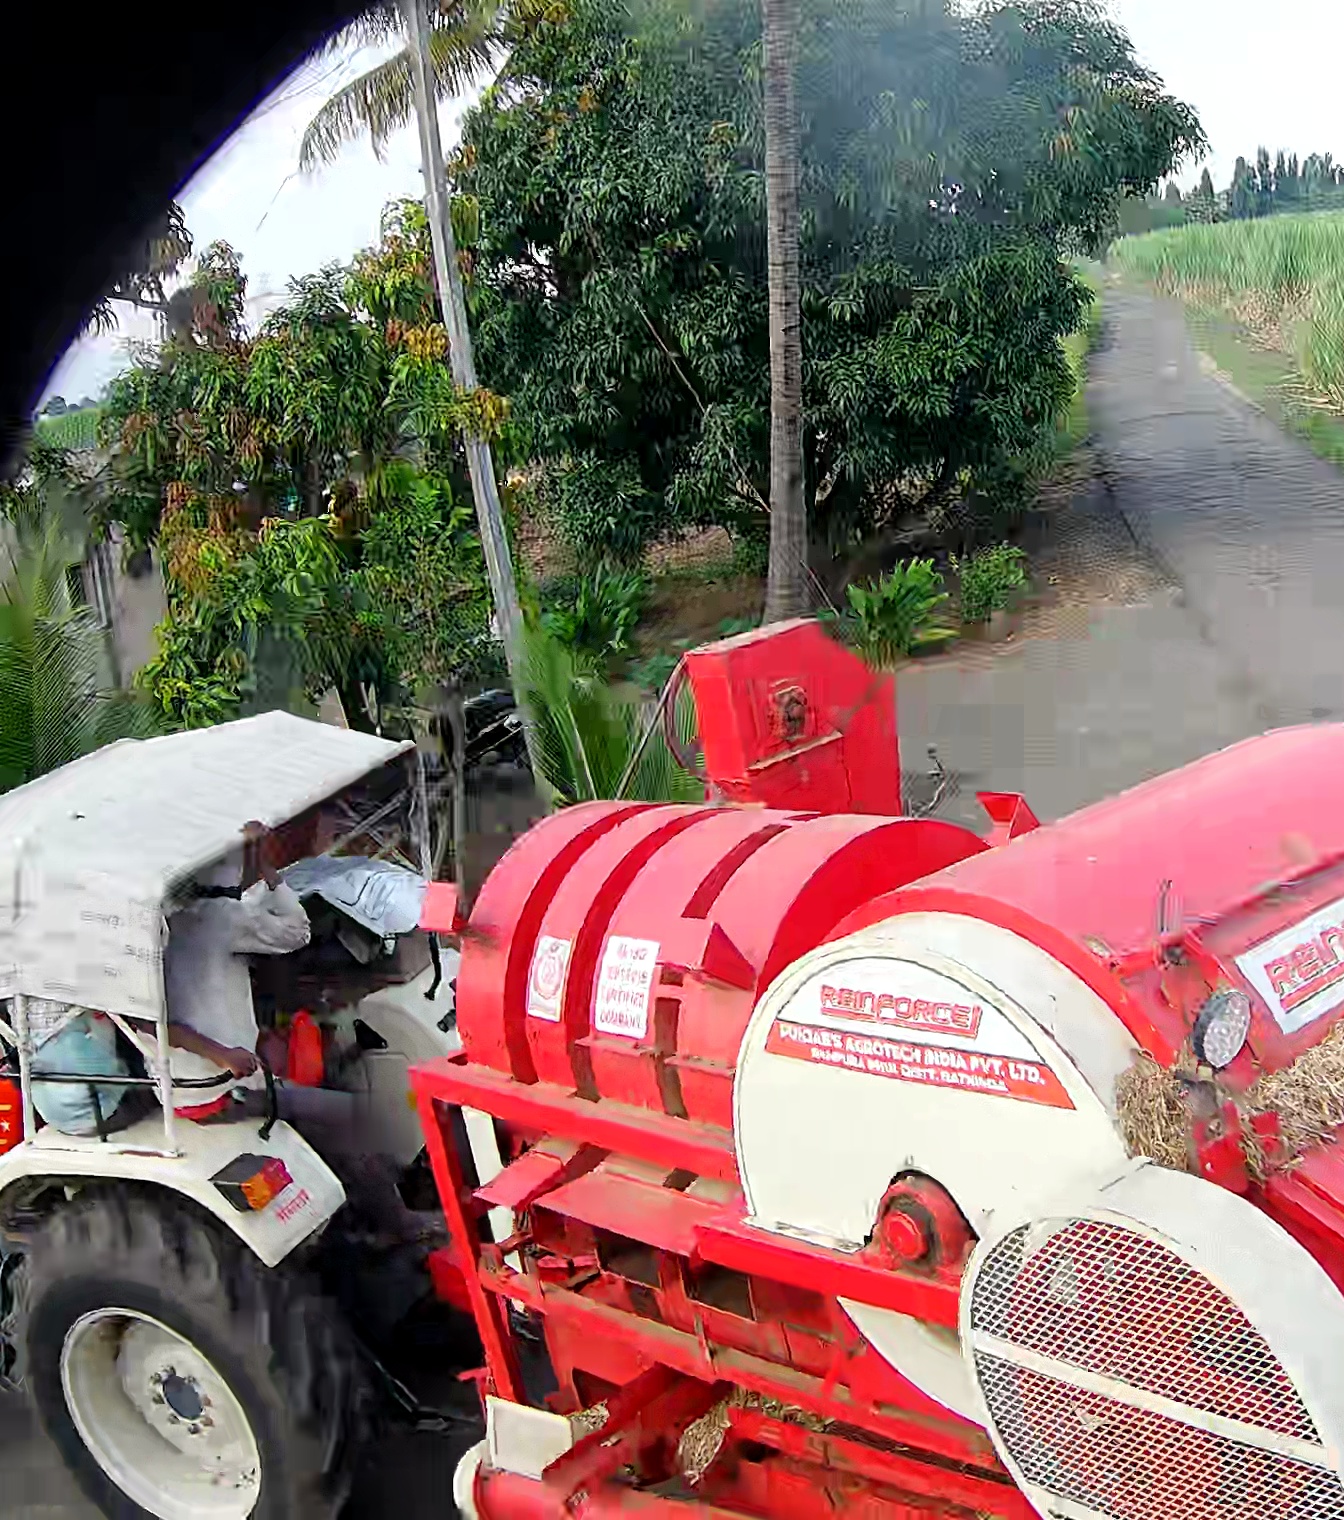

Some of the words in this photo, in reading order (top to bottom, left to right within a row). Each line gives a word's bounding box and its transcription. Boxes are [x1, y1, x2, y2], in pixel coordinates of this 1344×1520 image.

[924, 1049, 968, 1071] INDIA
[970, 1055, 1005, 1077] PVT.
[1008, 1062, 1046, 1085] LTD.
